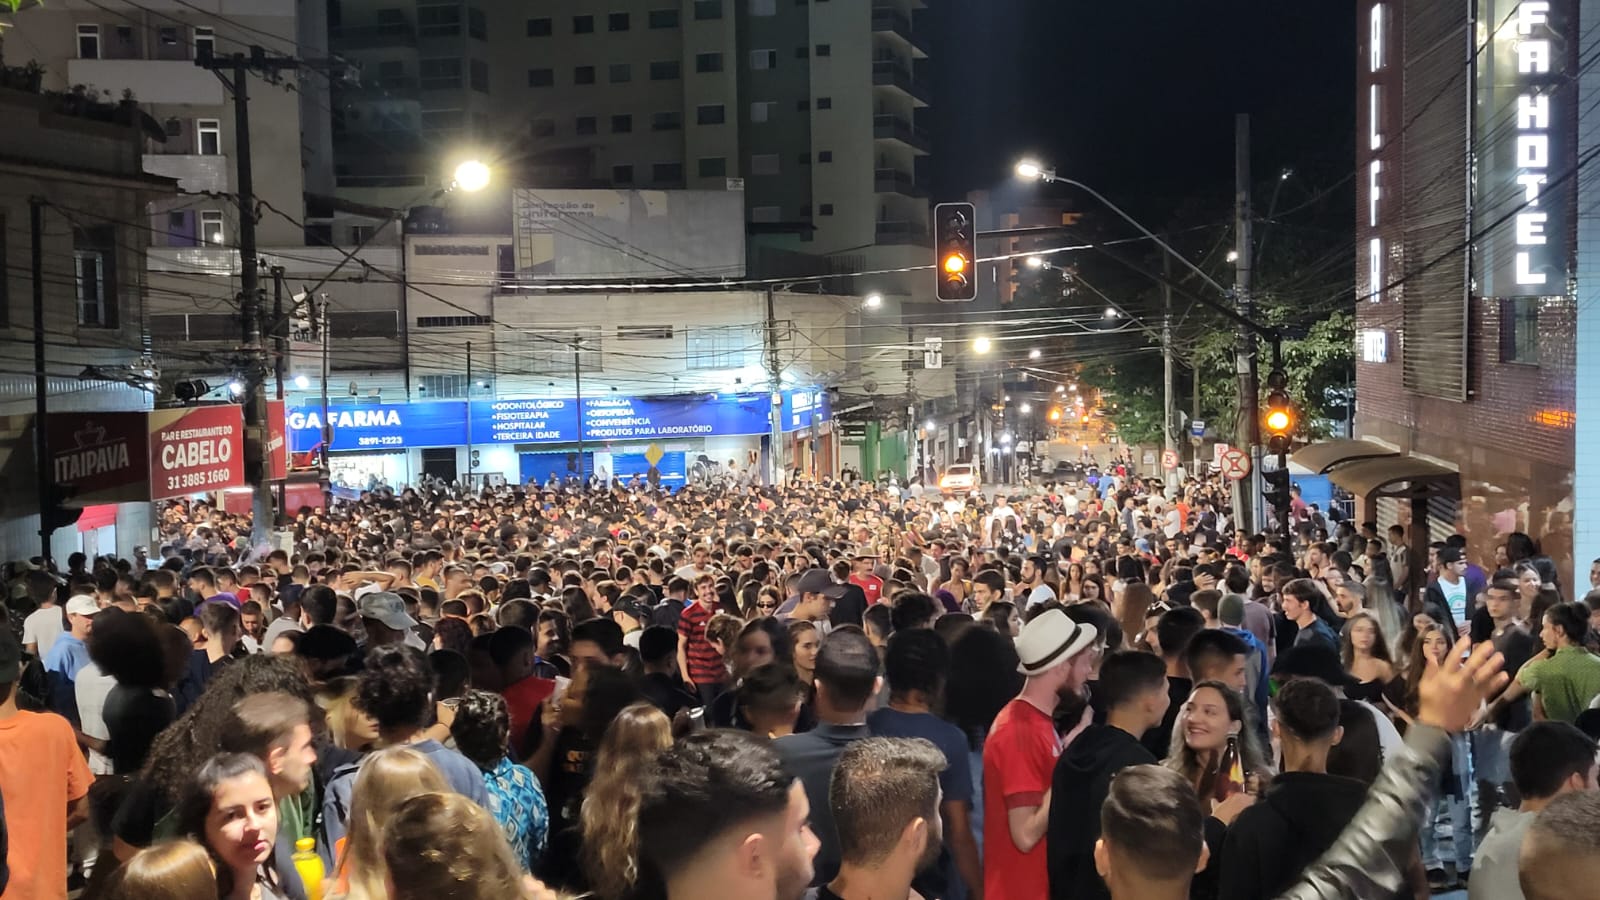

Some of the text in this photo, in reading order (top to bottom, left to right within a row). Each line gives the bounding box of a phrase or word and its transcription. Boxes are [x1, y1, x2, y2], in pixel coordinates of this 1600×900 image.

[1370, 3, 1381, 303] ALFA
[1516, 95, 1549, 284] HOTEL
[496, 400, 564, 410] ODONTOLÓGICO
[327, 410, 401, 428] FARMA
[496, 411, 549, 420] FISIOTERAPIA
[590, 417, 651, 427] CONVENIÊNCIA
[161, 425, 233, 441] BAR E RESTAURANTE DO
[497, 422, 546, 430] HOSPITALAR
[591, 424, 713, 437] PRODUTOS PARA LABORATÓRIO
[498, 431, 560, 440] TERCEIRA IDADE
[161, 438, 232, 470] CABELO
[54, 442, 130, 483] ITAIPAVA
[167, 468, 230, 490] 31 3885 1660
